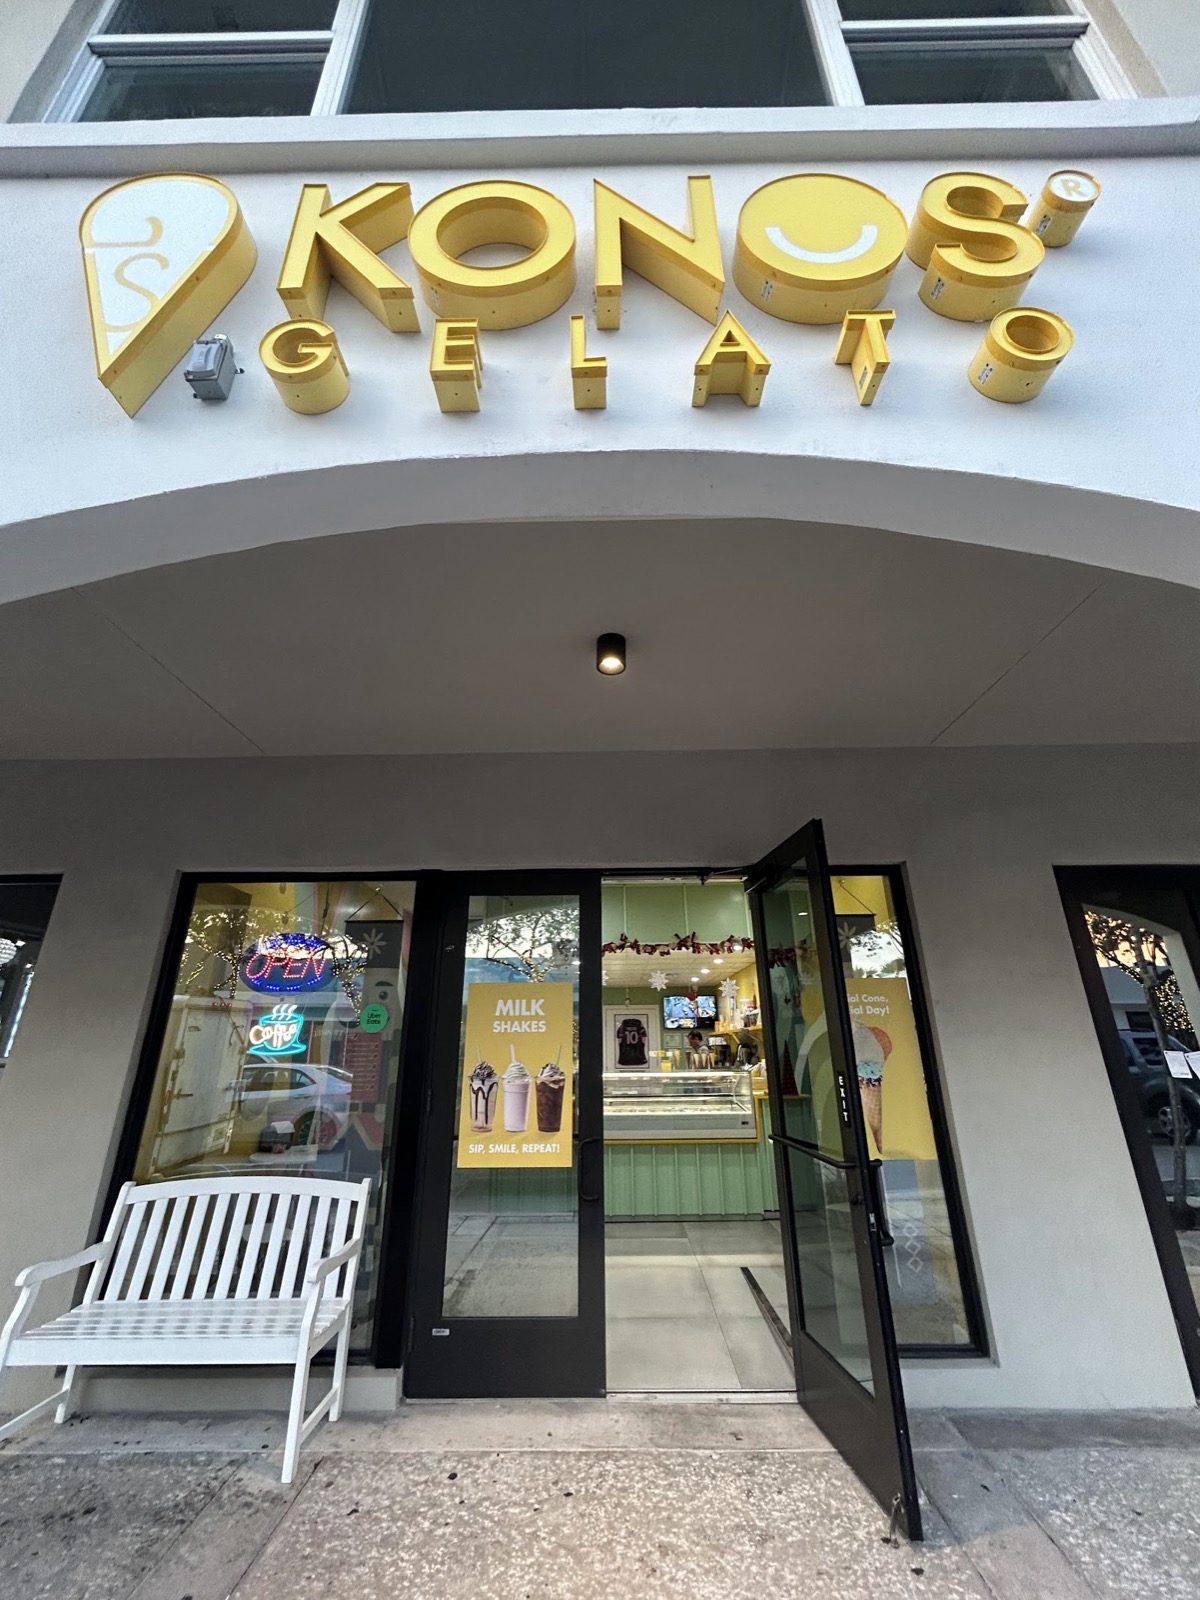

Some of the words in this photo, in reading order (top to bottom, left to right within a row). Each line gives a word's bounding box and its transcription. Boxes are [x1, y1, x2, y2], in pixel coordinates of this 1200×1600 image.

[259, 308, 1075, 402] GELATO
[245, 948, 326, 979] OPEN
[861, 994, 888, 1003] Cone,
[495, 999, 545, 1016] MILK
[865, 1005, 889, 1016] Day!
[492, 1021, 546, 1033] SHAKES
[250, 1023, 298, 1048] Coffee
[625, 1031, 638, 1044] 10
[838, 1075, 848, 1122] EXIT
[468, 1144, 485, 1154] SIP,
[488, 1144, 519, 1154] SMILE,
[522, 1144, 560, 1153] REPEAT!
